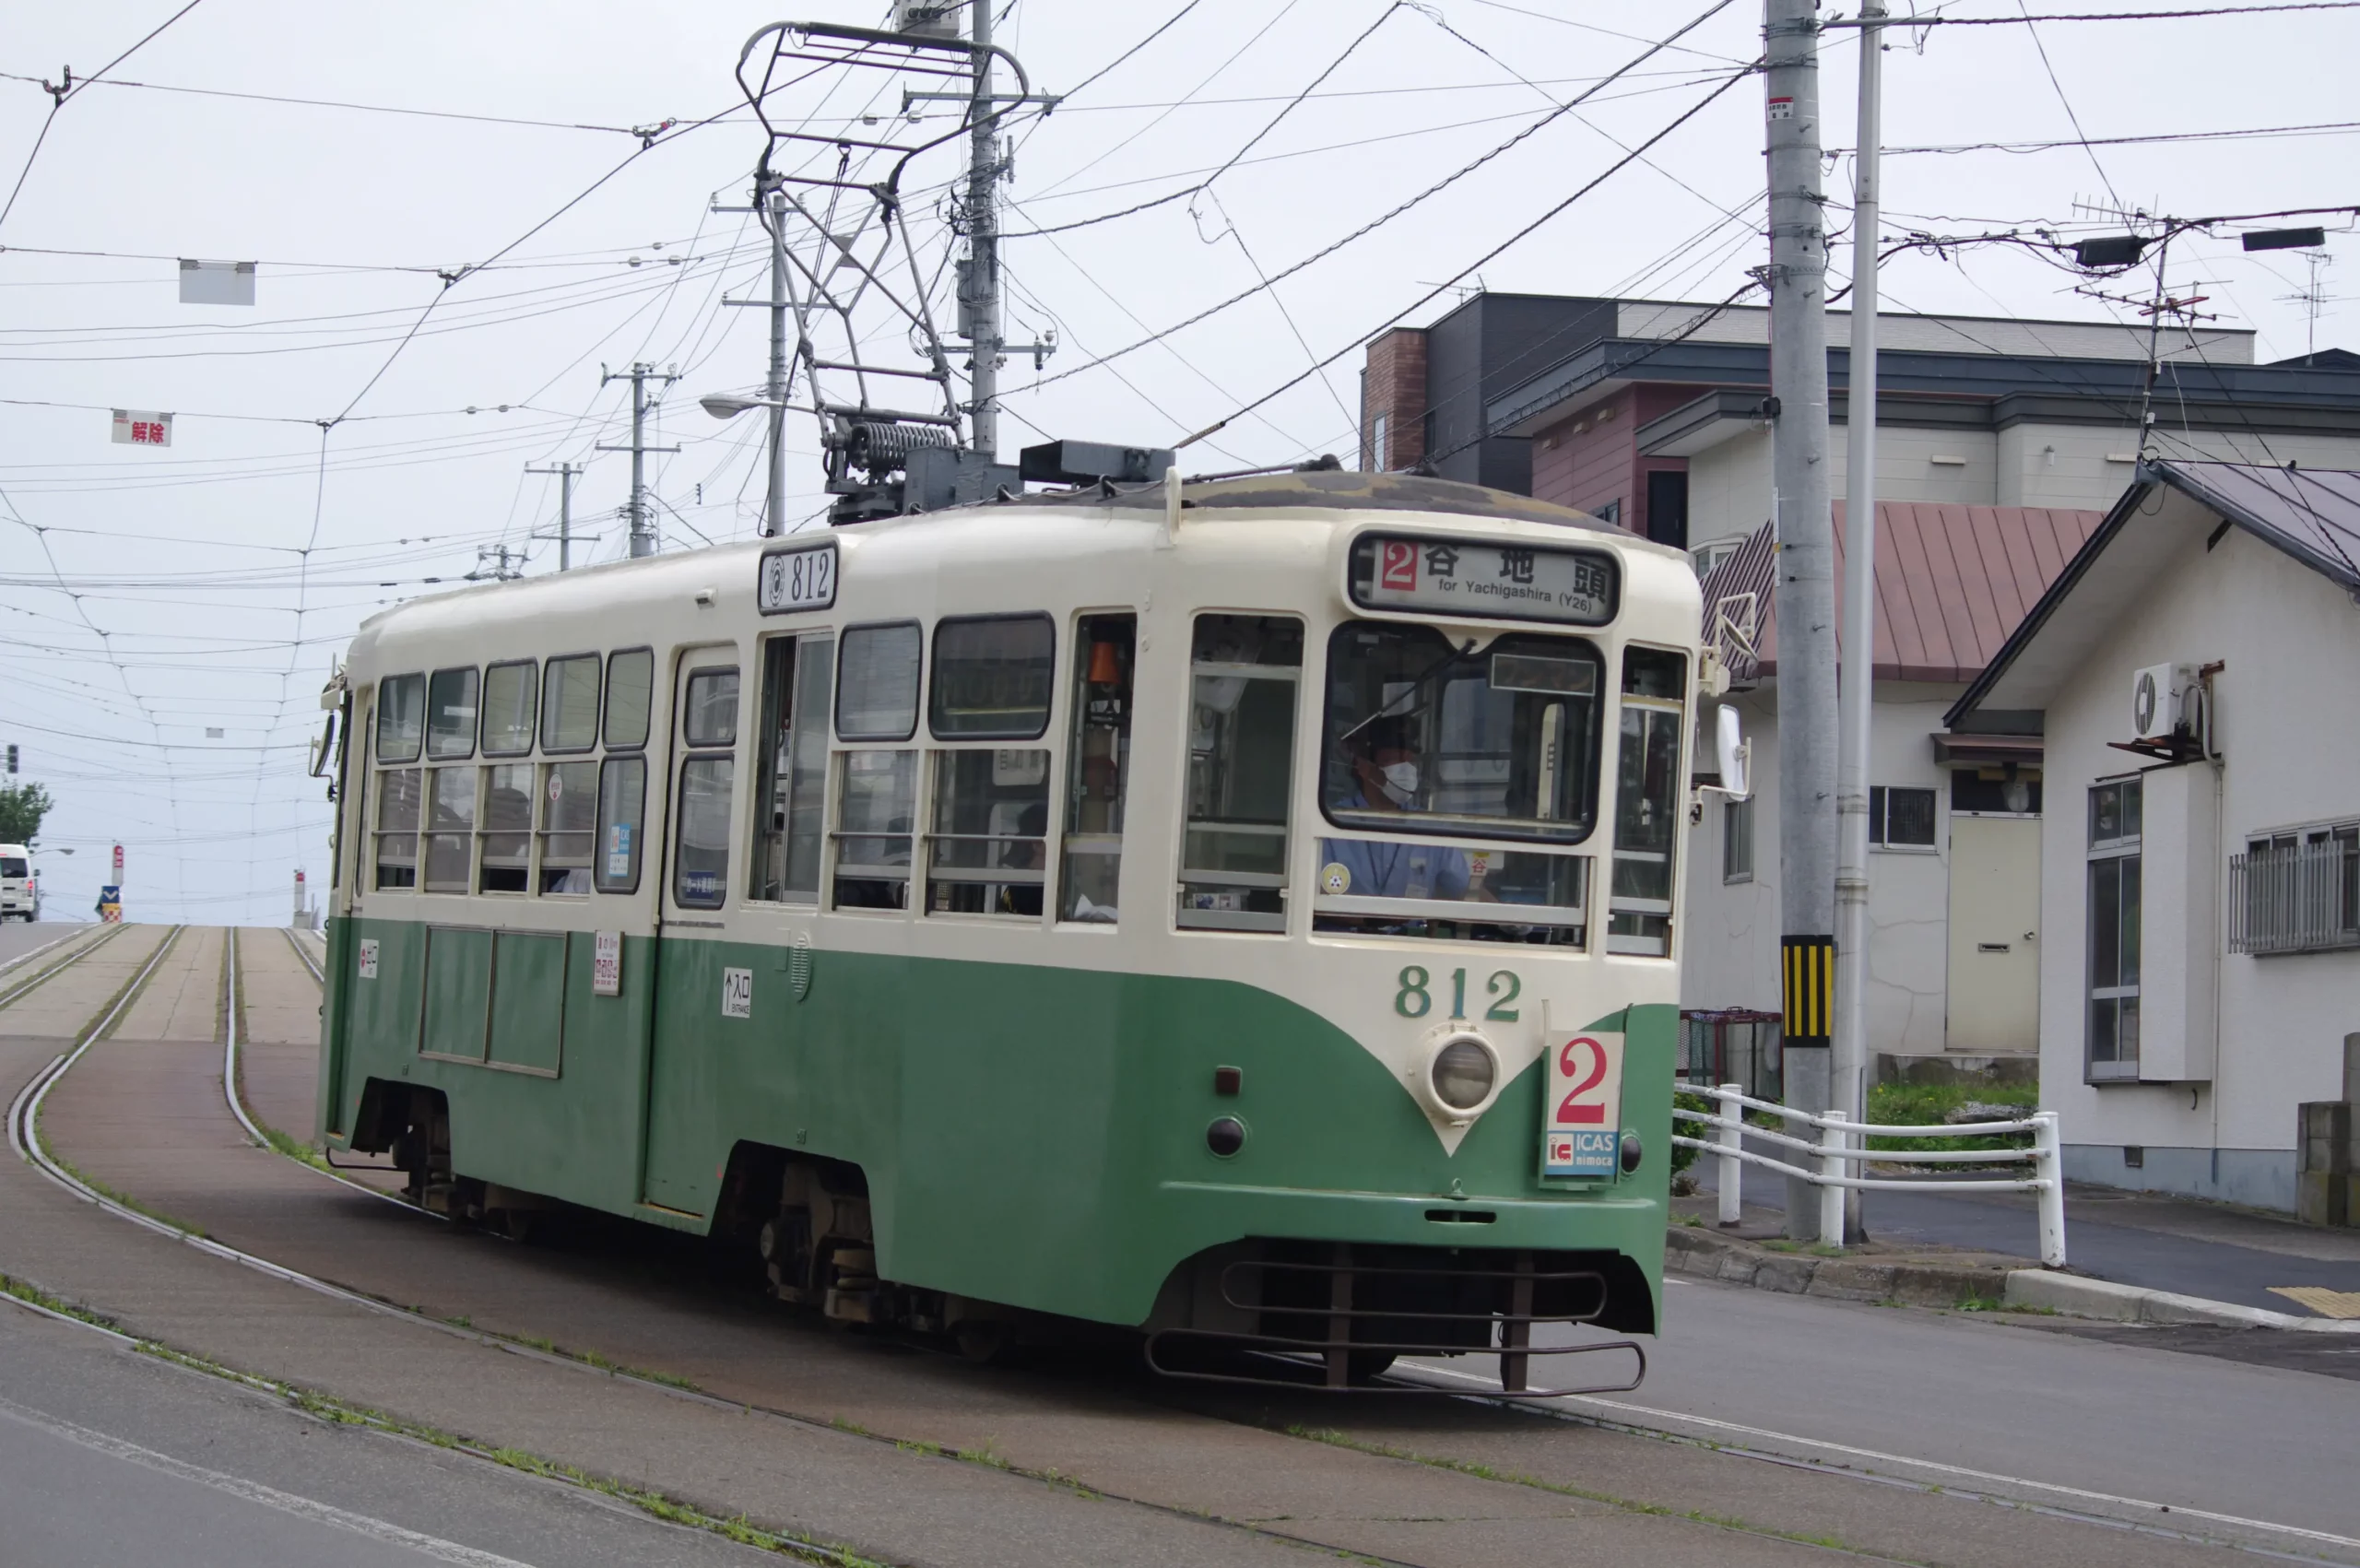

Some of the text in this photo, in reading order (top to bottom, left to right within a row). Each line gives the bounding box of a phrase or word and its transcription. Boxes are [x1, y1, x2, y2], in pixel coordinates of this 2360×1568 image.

[132, 421, 165, 443] 解除
[791, 551, 830, 602] 812
[1386, 542, 1413, 584] 2
[1439, 578, 1592, 616] for Yachigashira (Y26)
[733, 973, 750, 1000] 入口
[1395, 965, 1521, 1022] 812
[731, 1003, 750, 1015] ENTRANCE
[1556, 1037, 1608, 1124] 2
[1575, 1133, 1614, 1152] ICAS
[1575, 1154, 1613, 1167] nimoca
